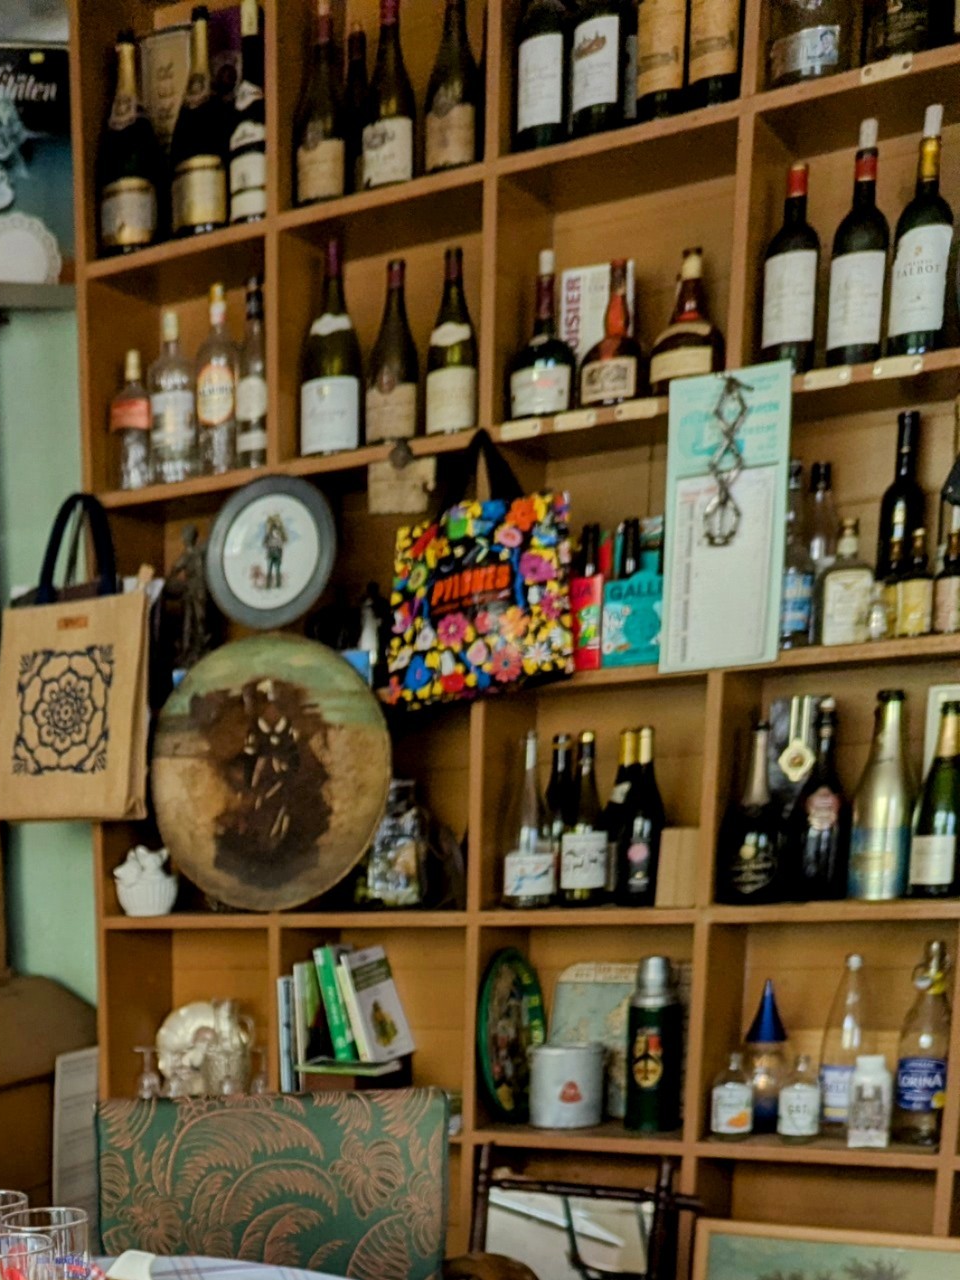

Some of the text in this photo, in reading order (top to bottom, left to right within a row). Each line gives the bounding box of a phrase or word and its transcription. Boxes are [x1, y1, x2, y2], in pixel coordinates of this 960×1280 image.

[897, 264, 942, 279] TALBOT
[565, 276, 581, 349] OISIER
[610, 579, 663, 601] GALLI
[900, 1072, 942, 1088] ORINA
